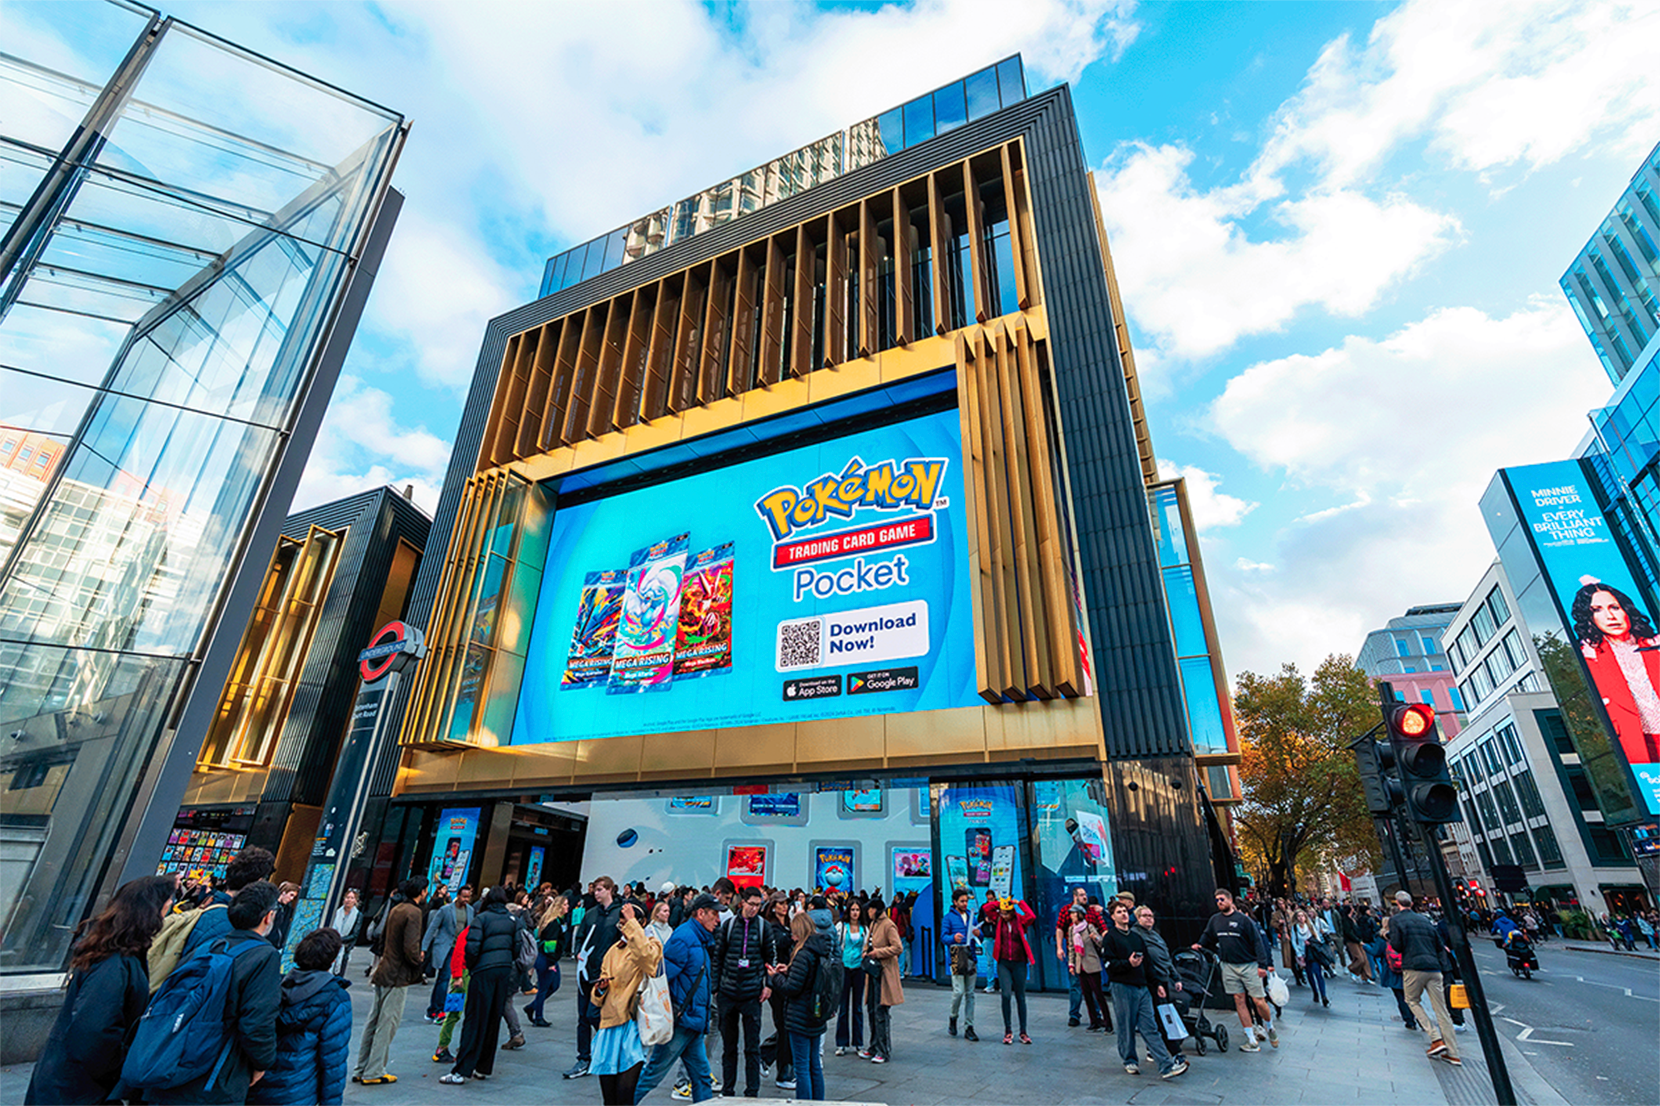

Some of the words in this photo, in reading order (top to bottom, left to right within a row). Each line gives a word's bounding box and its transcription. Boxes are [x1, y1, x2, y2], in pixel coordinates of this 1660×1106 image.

[1531, 485, 1578, 498] MINNIE
[1535, 494, 1582, 507] DRIVER
[1542, 509, 1584, 522] EVERY
[1533, 516, 1602, 533] BRILLIANT
[1549, 527, 1595, 540] THING
[789, 539, 839, 560] TRADING
[843, 532, 875, 550] CARD
[879, 524, 916, 543] GAME
[795, 555, 907, 600] Pocket
[830, 612, 917, 637] Download
[361, 642, 406, 658] UNDERGROUND
[676, 648, 698, 660] MEGA
[699, 643, 727, 655] RISING
[830, 636, 875, 654] Now!
[568, 660, 588, 669] MEGA
[615, 658, 637, 669] MEGA
[639, 654, 670, 666] RISING
[867, 678, 896, 689] Google
[897, 676, 915, 687] Play
[799, 687, 816, 698] App
[816, 685, 838, 695] Store
